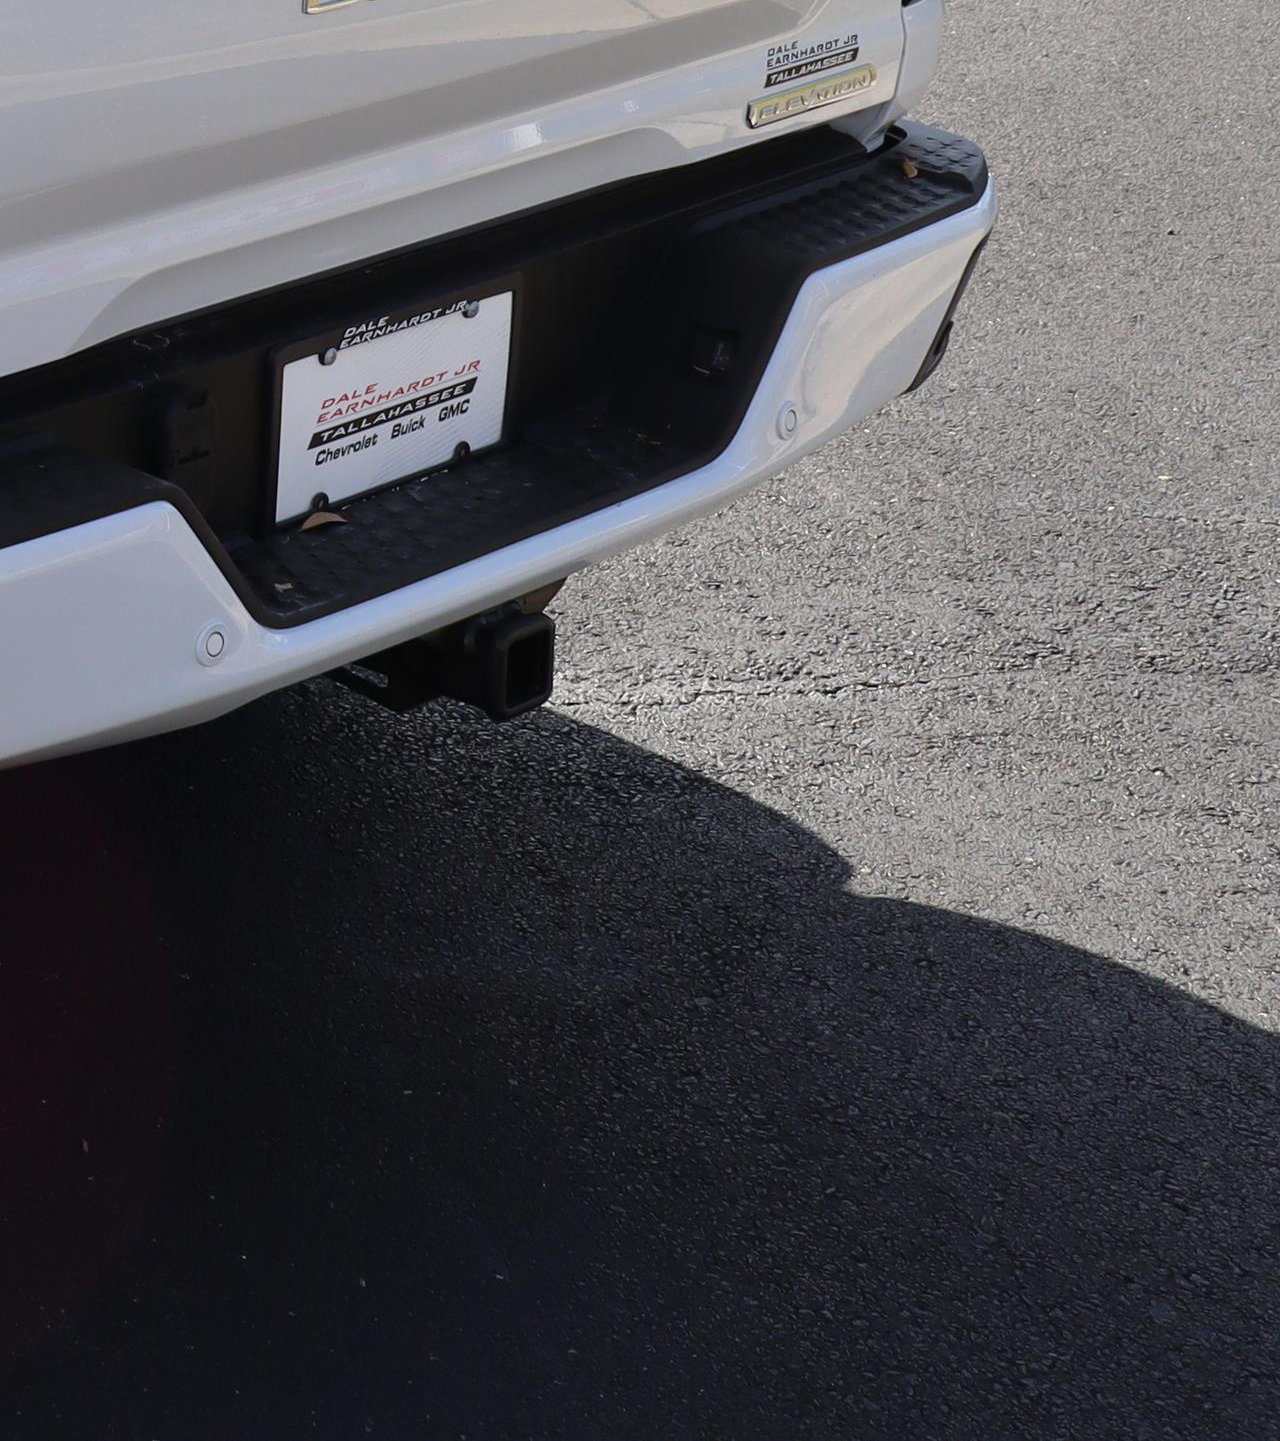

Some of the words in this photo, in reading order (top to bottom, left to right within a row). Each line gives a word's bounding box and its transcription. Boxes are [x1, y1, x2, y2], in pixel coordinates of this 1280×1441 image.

[767, 40, 798, 57] DALE
[767, 38, 840, 68] EARNHARDT
[844, 34, 858, 46] JR
[770, 51, 854, 84] TALLAHASSEE
[339, 308, 442, 349] EARNHARDT
[445, 300, 467, 314] JR
[343, 316, 389, 338] DALE
[316, 371, 448, 424] EARNHARDT
[454, 360, 481, 376] JR
[321, 383, 378, 409] DALE
[320, 384, 466, 442] TALLAHASSEE
[315, 433, 378, 466] Chevrolet
[391, 415, 426, 439] Buick
[438, 399, 470, 422] GMC
